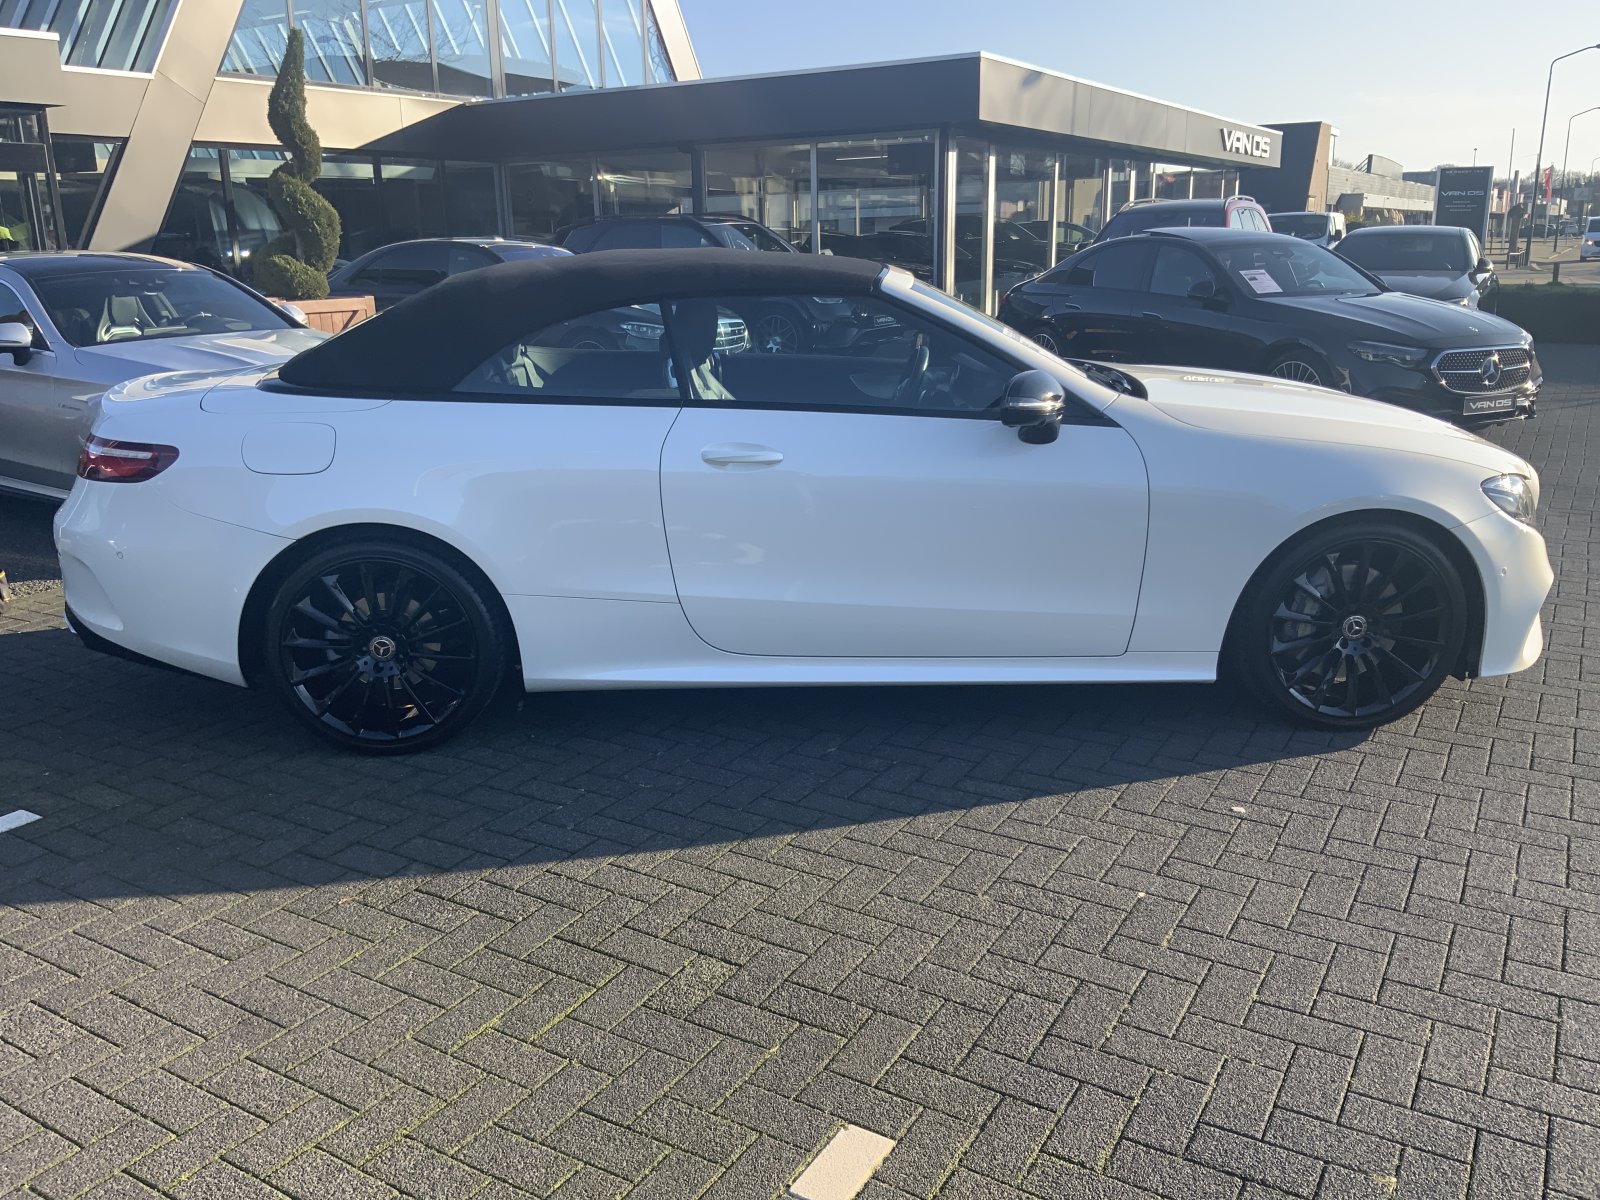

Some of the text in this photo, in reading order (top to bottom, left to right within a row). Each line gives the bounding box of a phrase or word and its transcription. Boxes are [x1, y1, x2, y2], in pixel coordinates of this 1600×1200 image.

[1223, 127, 1271, 158] VAN OS
[1470, 399, 1512, 410] VAN OS
